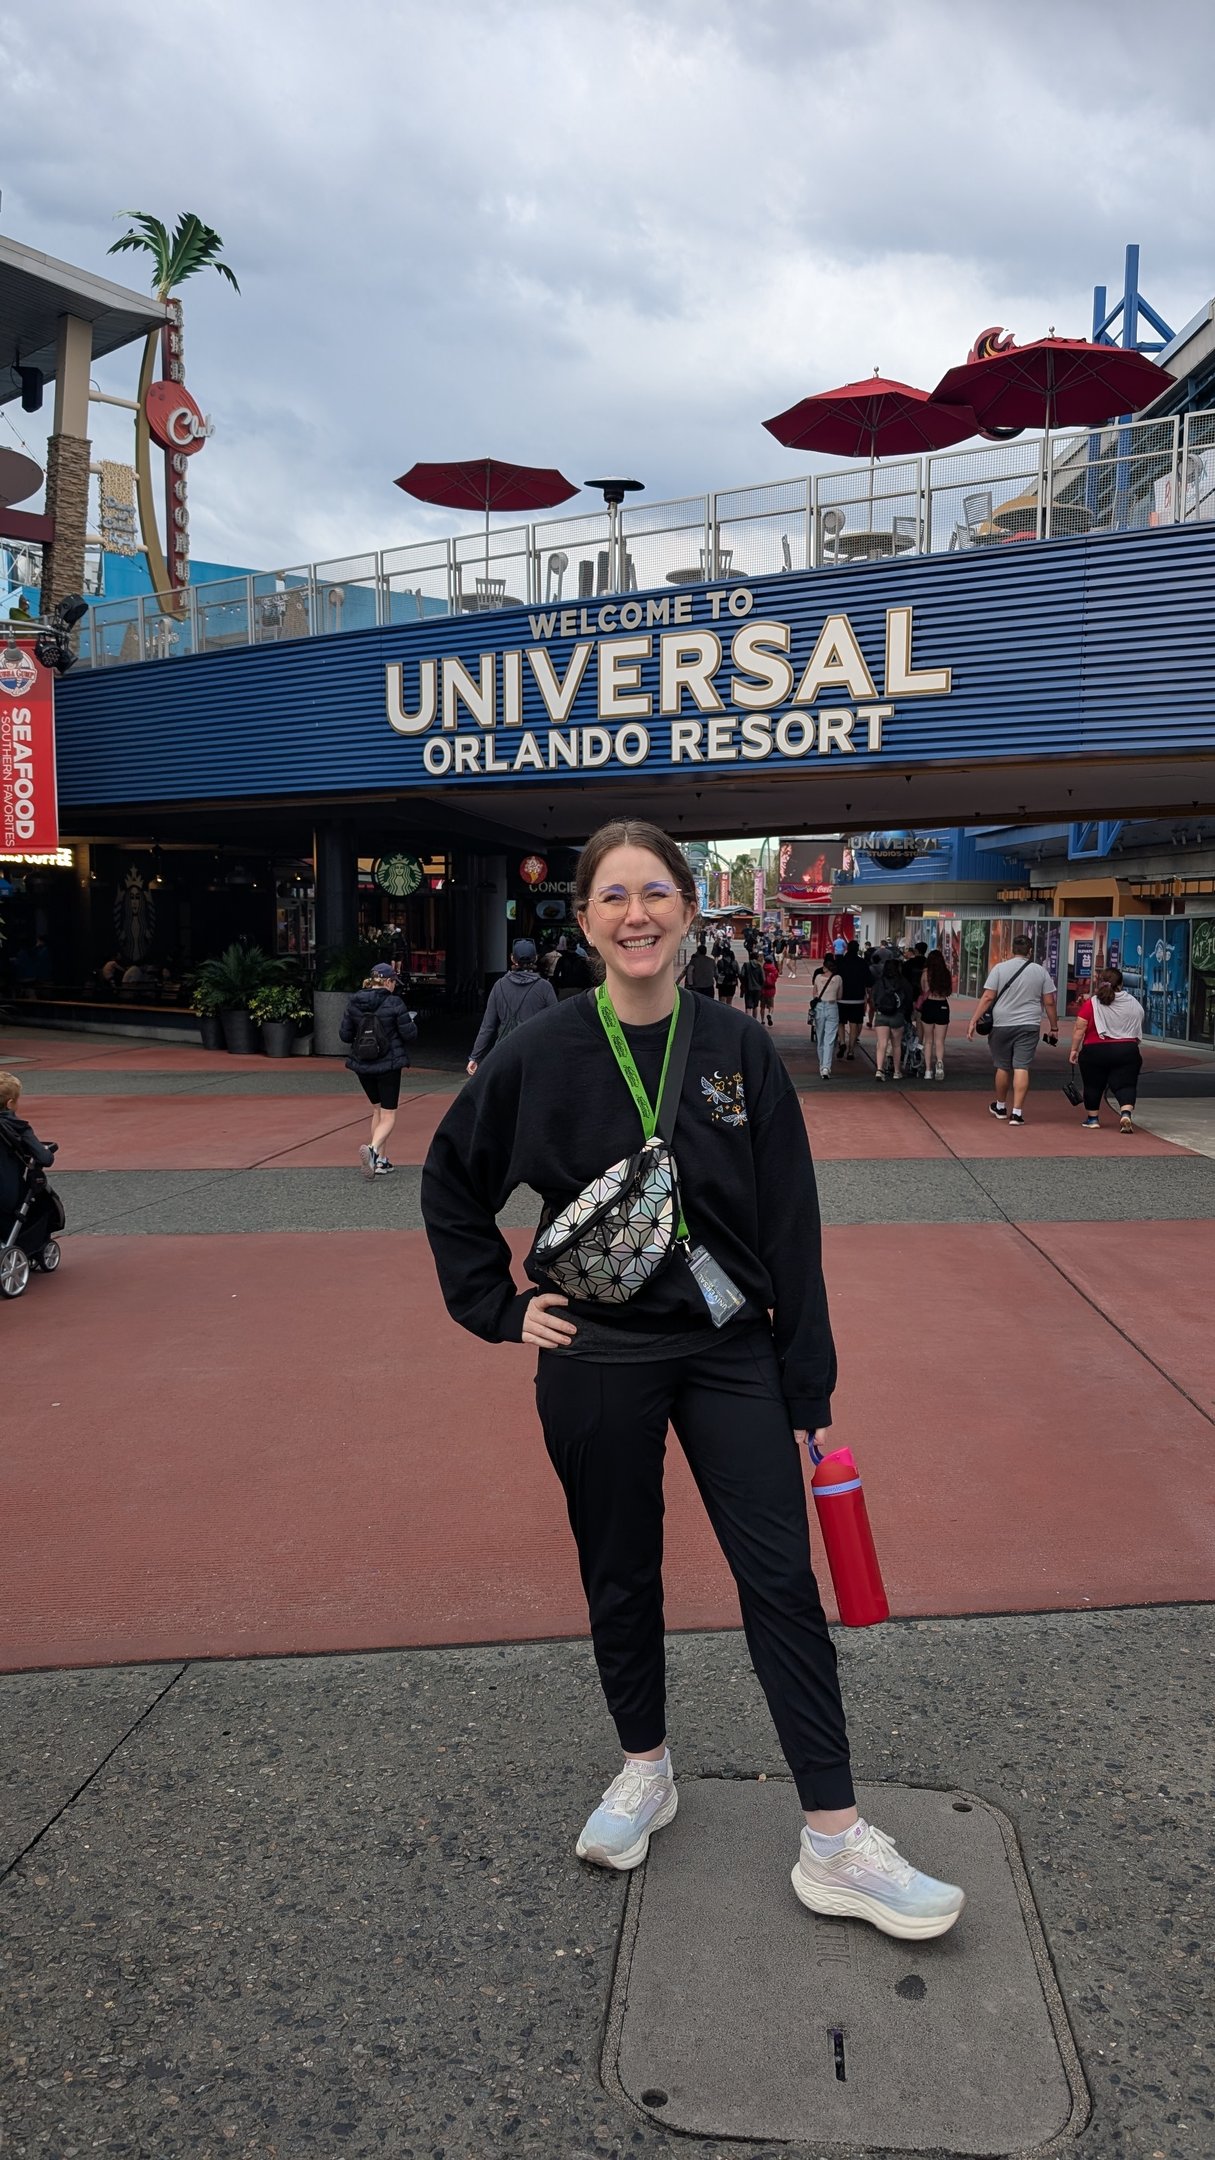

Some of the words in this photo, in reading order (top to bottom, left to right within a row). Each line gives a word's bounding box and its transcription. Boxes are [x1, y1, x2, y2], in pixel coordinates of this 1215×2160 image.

[166, 407, 216, 445] Club
[172, 453, 191, 608] OCONUT
[528, 597, 693, 640] WELCOME
[705, 587, 753, 620] TO
[385, 606, 953, 736] UNIVERSAL
[1, 716, 13, 781] SOUTHERN
[422, 722, 651, 777] ORLANDO
[670, 704, 895, 764] RESORT
[12, 707, 35, 839] SEAFOOD
[3, 784, 15, 847] FAVORITES
[529, 881, 577, 893] CONCIE
[699, 1273, 728, 1310] UNIVERSAL
[814, 1920, 851, 1968] CTRIC
